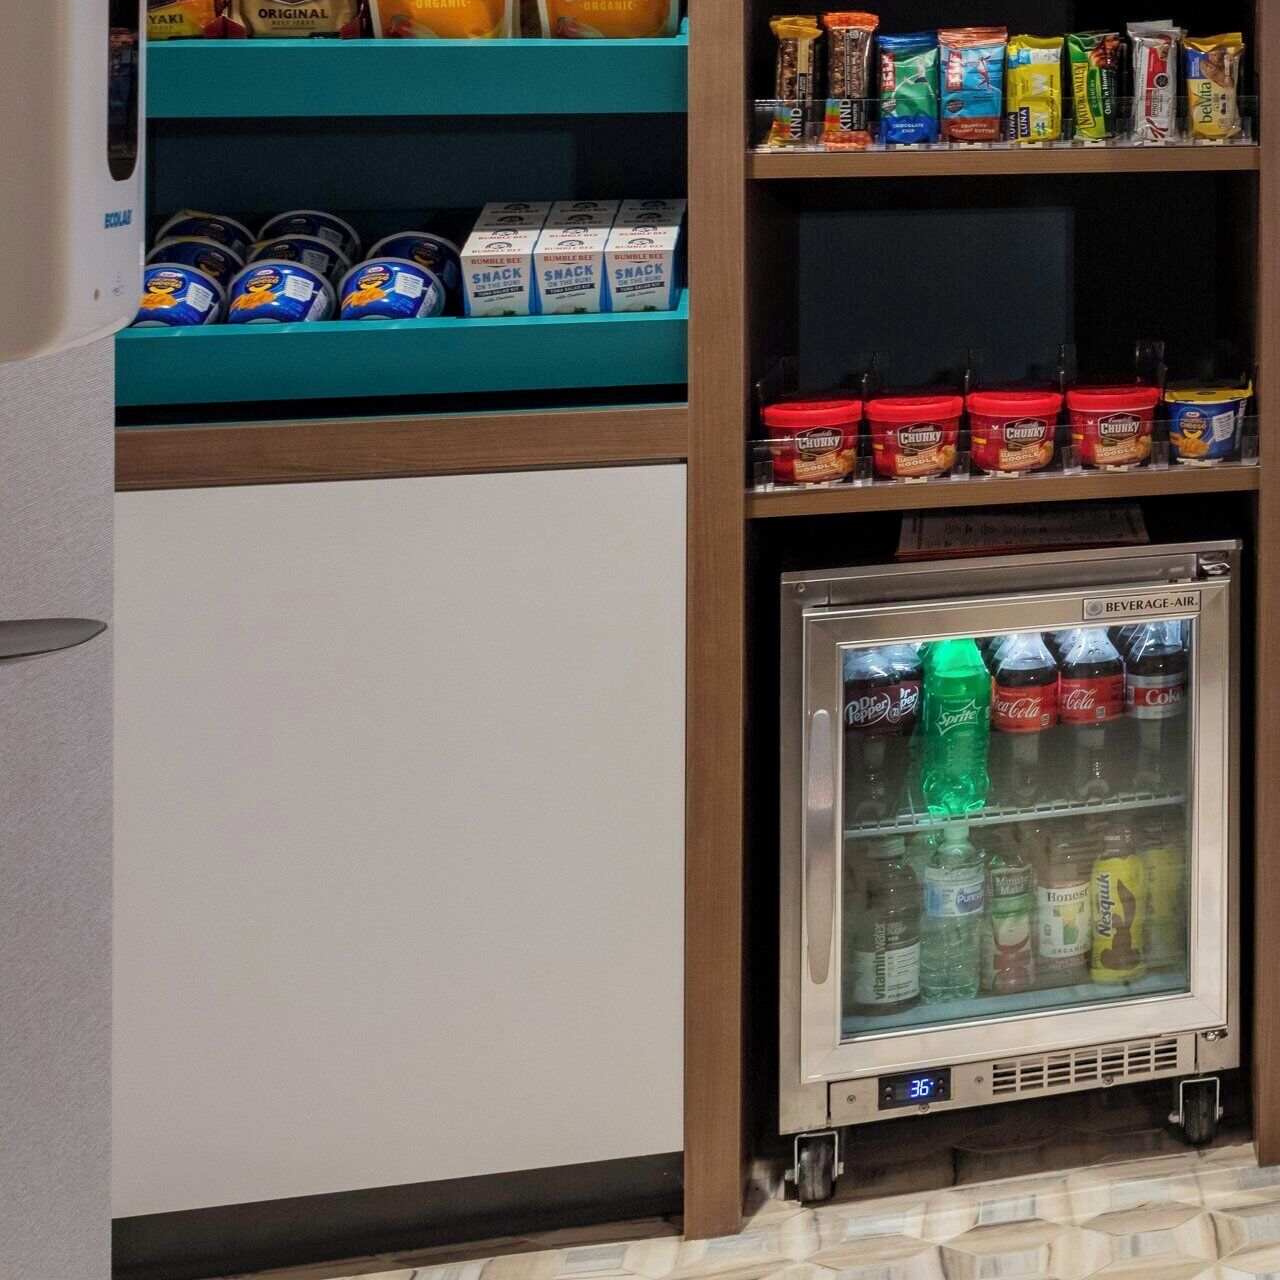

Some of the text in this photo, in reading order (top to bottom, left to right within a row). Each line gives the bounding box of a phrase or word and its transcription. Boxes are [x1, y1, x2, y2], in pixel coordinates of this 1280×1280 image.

[258, 8, 328, 19] ORIGINAL
[1074, 64, 1093, 127] NATURE VALLEY
[1198, 82, 1212, 124] belVita
[790, 107, 803, 141] KIND
[839, 99, 851, 132] KIND
[1021, 109, 1029, 136] LUNA
[104, 210, 132, 229] ECOLAB
[472, 268, 522, 284] SNACK
[544, 266, 593, 282] SNACK
[615, 264, 663, 280] SNACK
[505, 279, 521, 287] RUN!
[798, 436, 840, 450] CHUNKY
[900, 430, 942, 445] CHUNKY
[1105, 598, 1196, 612] BEVERAGE-AIR
[859, 696, 877, 710] Dr
[849, 699, 888, 725] Pepper
[939, 709, 976, 727] Sprite
[1099, 873, 1115, 938] Nesquik
